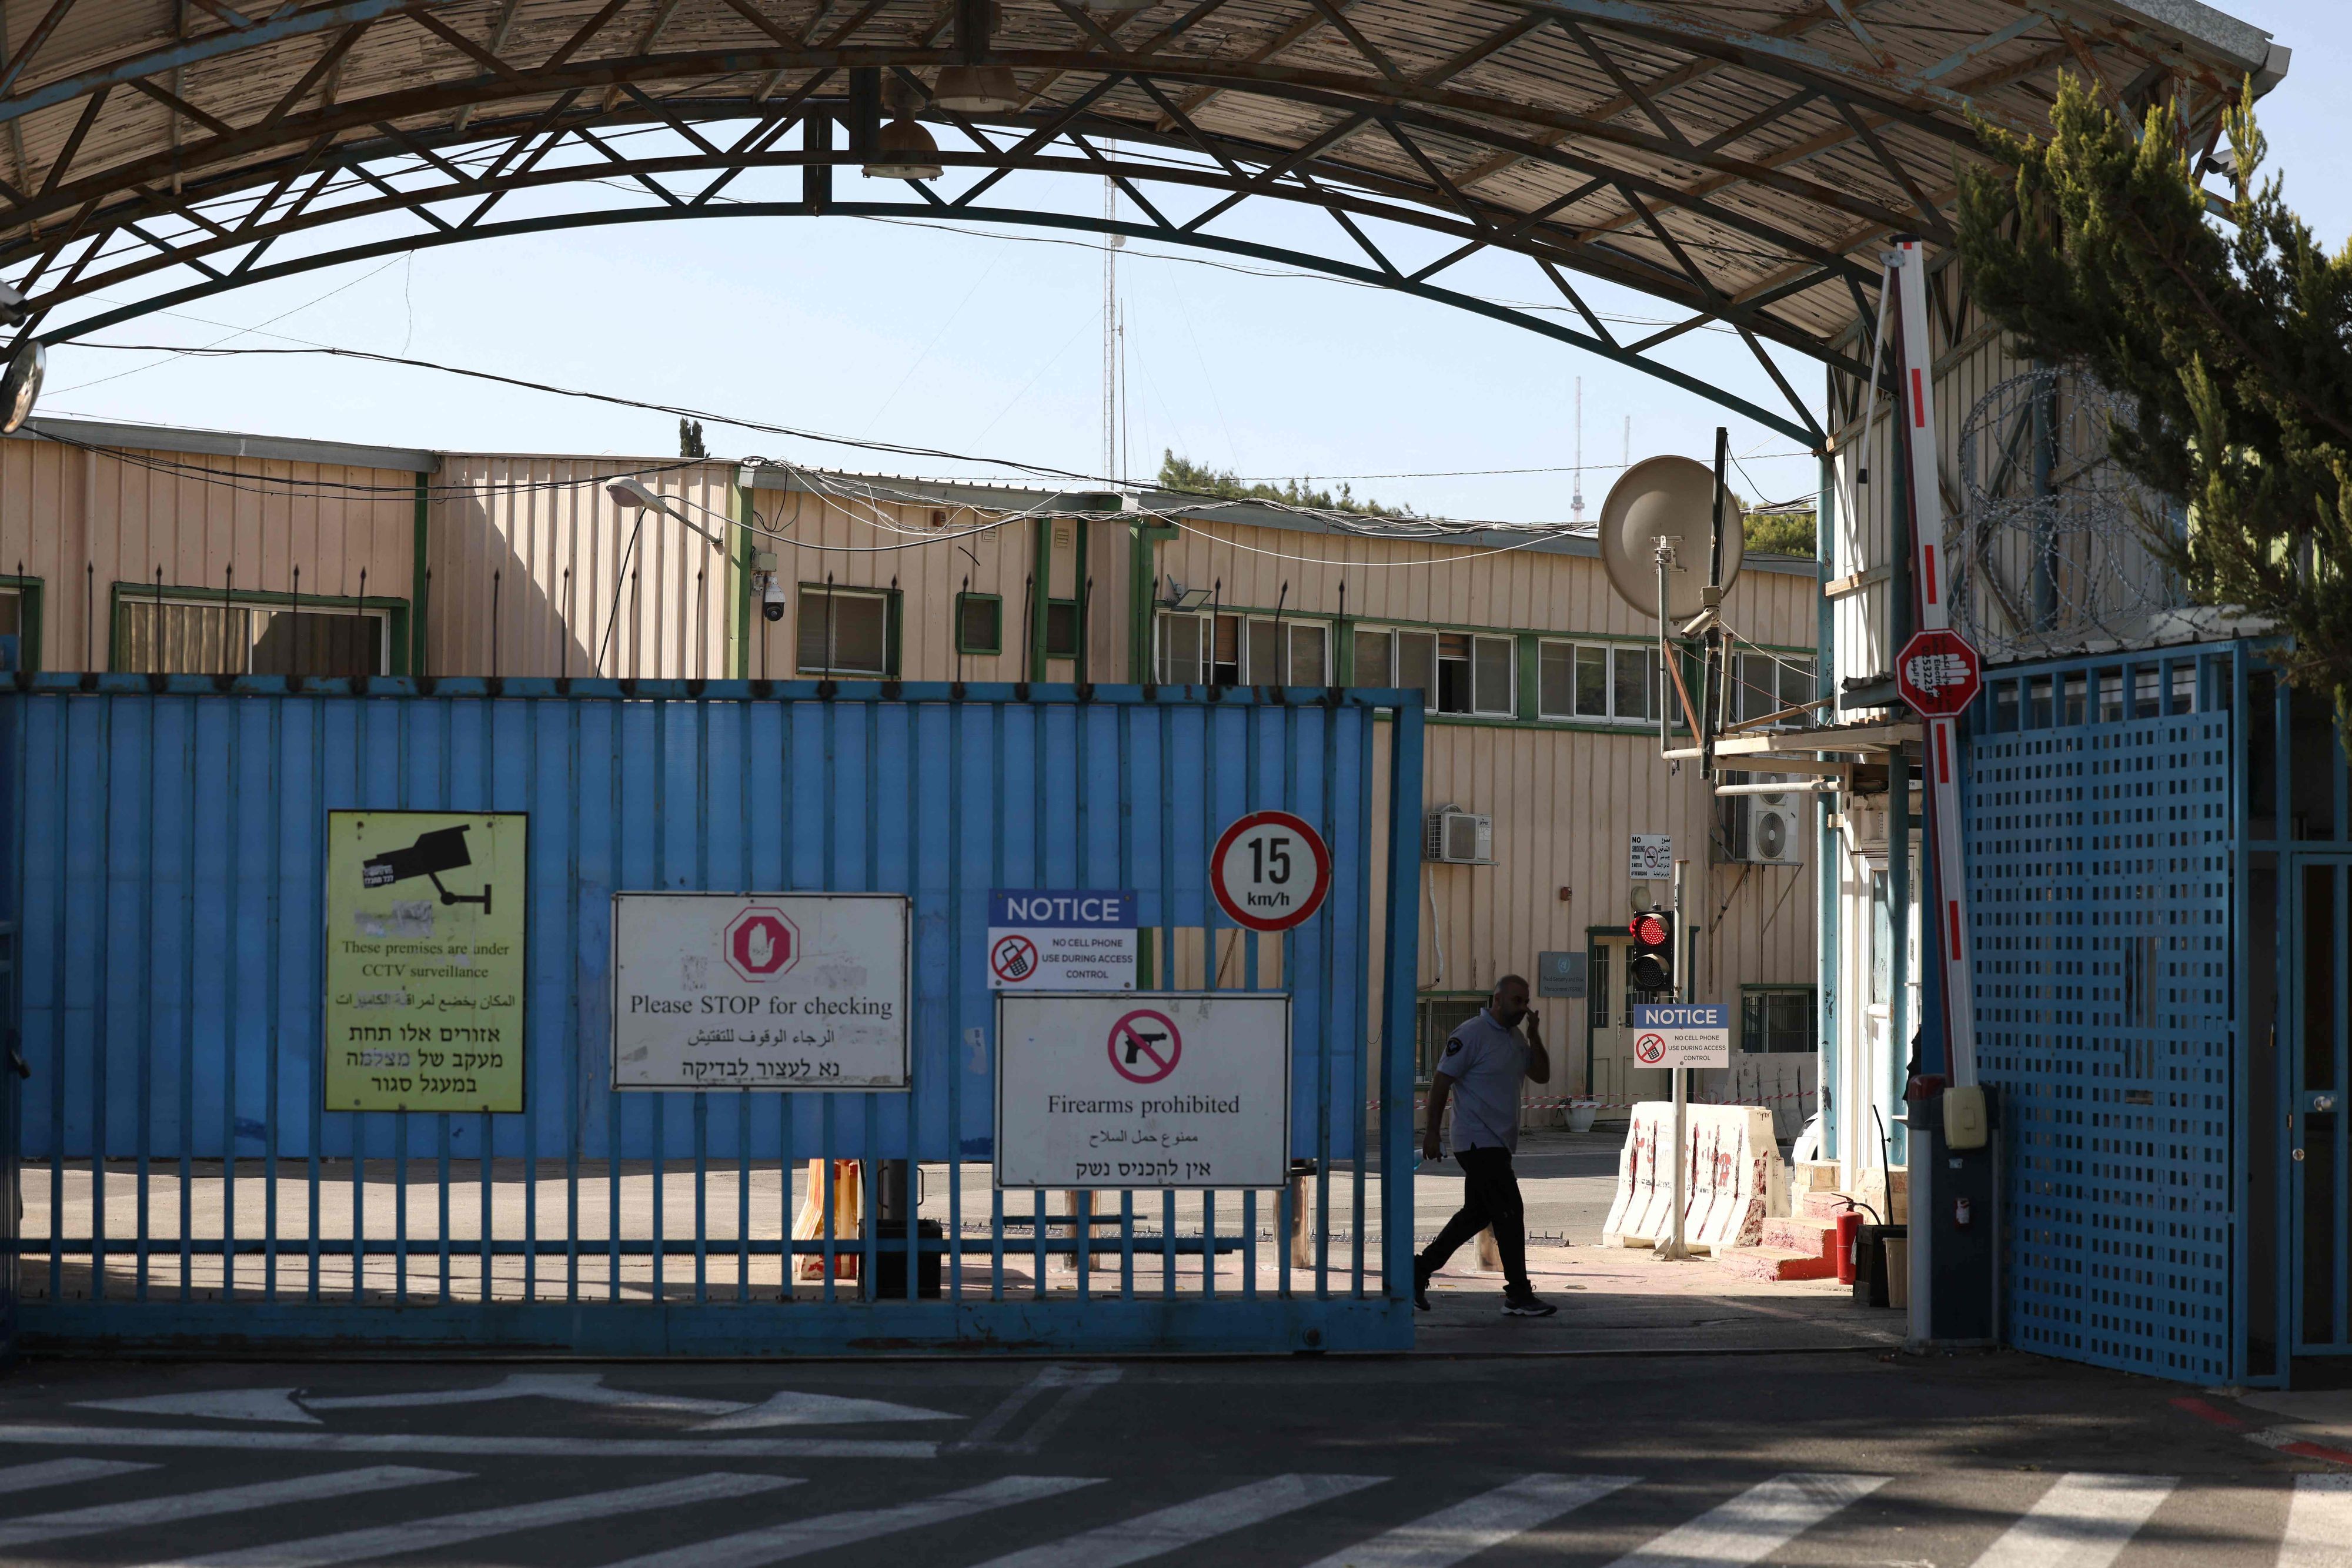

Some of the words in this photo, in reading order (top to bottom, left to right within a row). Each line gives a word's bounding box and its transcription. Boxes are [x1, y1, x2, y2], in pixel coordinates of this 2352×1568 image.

[1248, 838, 1291, 884] 15
[1248, 892, 1289, 907] km/h
[1007, 898, 1120, 921] NOTICE
[343, 940, 380, 954] These
[386, 942, 443, 957] premises
[448, 945, 467, 954] are
[473, 942, 509, 955] under
[1053, 939, 1067, 947] NO
[1068, 939, 1089, 947] CELL
[1091, 939, 1122, 948] PHONE
[1042, 954, 1060, 962] USE
[1062, 954, 1097, 963] DURING
[1098, 955, 1133, 963] ACCESS
[362, 964, 405, 977] CCTV
[410, 965, 489, 977] surveillance
[1066, 970, 1108, 978] CONTROL
[439, 995, 476, 1011] يخضع
[480, 994, 515, 1009] المكان
[631, 995, 693, 1014] Please
[701, 995, 760, 1014] STOP
[769, 996, 797, 1014] for
[804, 997, 893, 1020] checking
[1646, 1009, 1717, 1024] NOTICE
[349, 1027, 391, 1041] תחת
[400, 1023, 431, 1041] אלו
[440, 1027, 500, 1042] אזורים
[688, 1028, 734, 1047] للتفتيش
[739, 1028, 786, 1047] الوقوف
[793, 1030, 834, 1047] الرجاء
[347, 1048, 410, 1067] מצלמה
[418, 1048, 445, 1067] של
[452, 1053, 503, 1071] מעקב
[683, 1058, 749, 1080] לבדיקה
[756, 1058, 811, 1077] לעצור
[819, 1062, 840, 1076] נא
[372, 1077, 412, 1092] סגור
[420, 1074, 477, 1093] במעגל
[1048, 1095, 1133, 1114] Firearms
[1141, 1095, 1240, 1118] prohibited
[1089, 1129, 1127, 1148] السلاح
[1132, 1130, 1158, 1144] حمل
[1161, 1134, 1198, 1148] ممنوع
[1076, 1162, 1110, 1180] נשק
[1118, 1159, 1178, 1177] להכניס
[1186, 1162, 1211, 1180] אין
